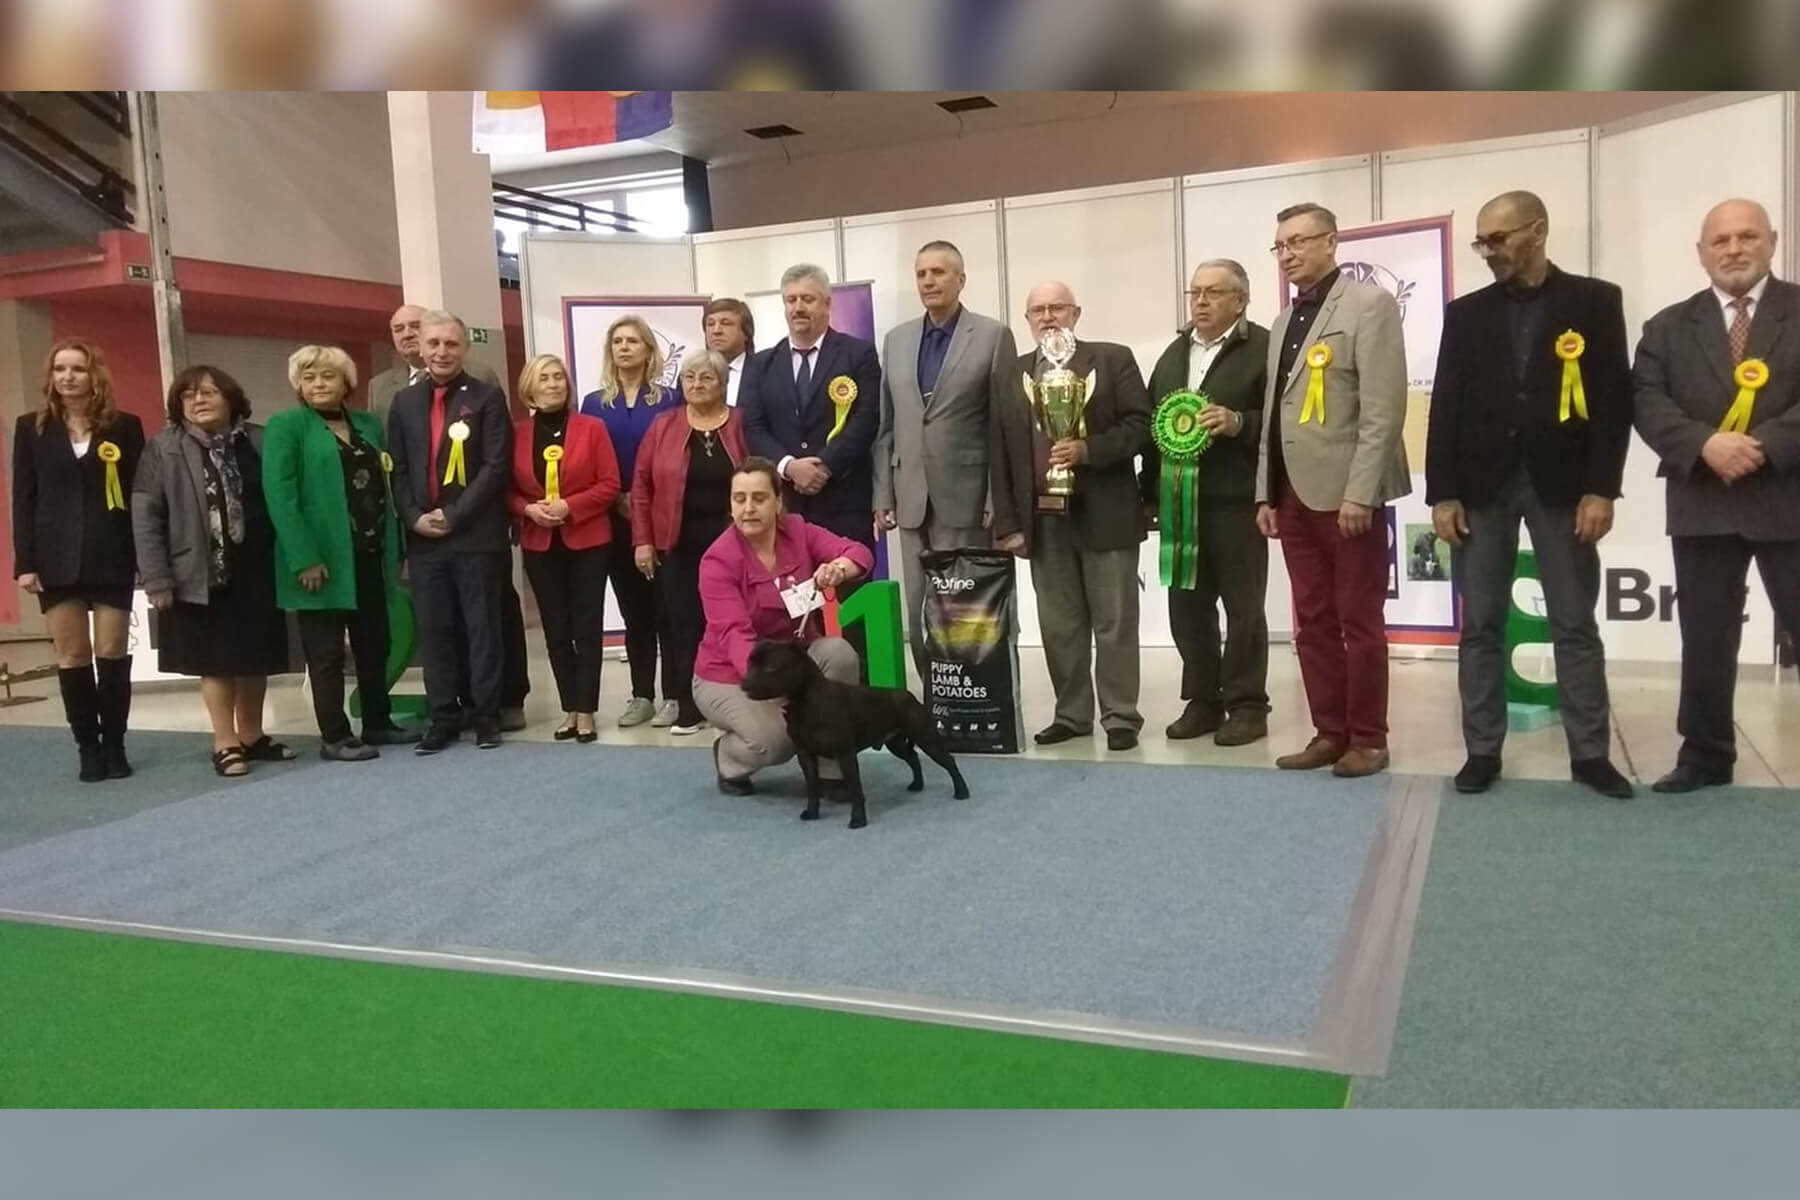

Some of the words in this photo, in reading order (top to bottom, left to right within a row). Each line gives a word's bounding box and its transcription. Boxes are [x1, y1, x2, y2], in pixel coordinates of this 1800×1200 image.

[837, 579, 900, 690] 1
[931, 661, 963, 675] PUPPY
[931, 673, 961, 686] LAMB
[963, 676, 973, 687] &
[931, 684, 987, 698] POTATOES
